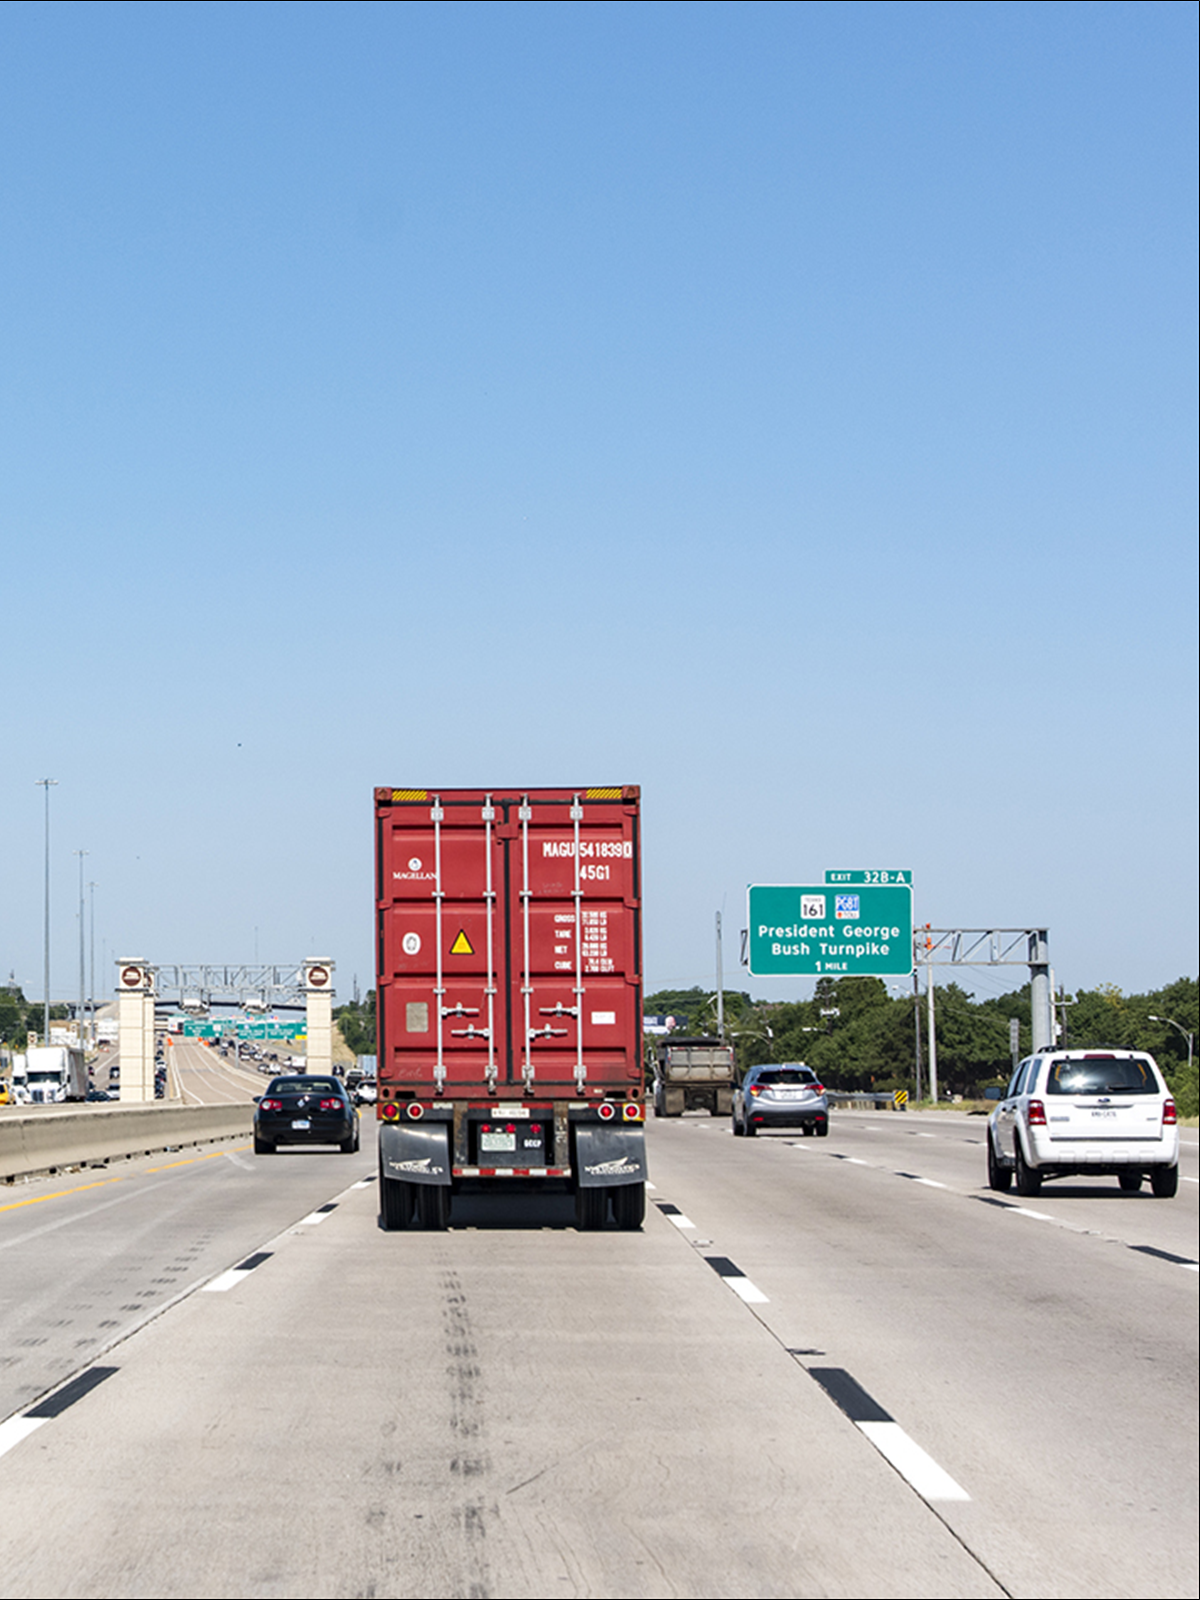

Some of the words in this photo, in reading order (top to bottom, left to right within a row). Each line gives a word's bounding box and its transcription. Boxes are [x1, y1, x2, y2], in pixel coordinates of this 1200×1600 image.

[543, 842, 575, 857] MAGU
[580, 865, 610, 880] 45G1
[830, 873, 852, 881] EXIT
[864, 872, 906, 883] 32B-A
[803, 903, 824, 917] 161
[758, 924, 835, 937] President
[842, 925, 900, 940] George
[771, 943, 810, 955] Bush
[819, 943, 890, 958] Turnpike
[815, 961, 822, 972] 1
[825, 962, 848, 971] MILE
